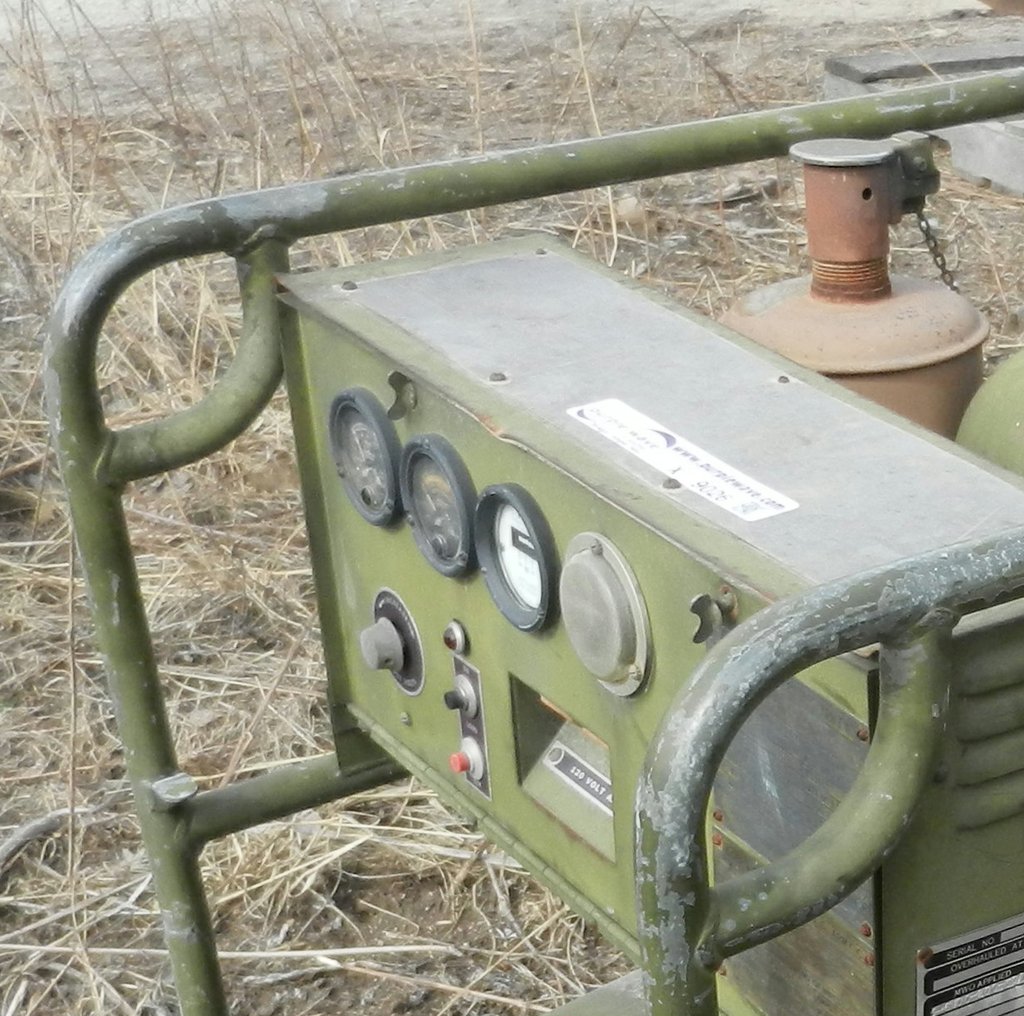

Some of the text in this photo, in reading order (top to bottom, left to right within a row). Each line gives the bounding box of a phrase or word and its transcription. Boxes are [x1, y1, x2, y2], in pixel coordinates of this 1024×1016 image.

[571, 766, 585, 780] 120
[586, 777, 606, 796] VOLT
[947, 936, 996, 961] SERIAL NO
[951, 941, 1024, 972] OVERHAULED AT
[954, 970, 1013, 997] MWO APPLIED
